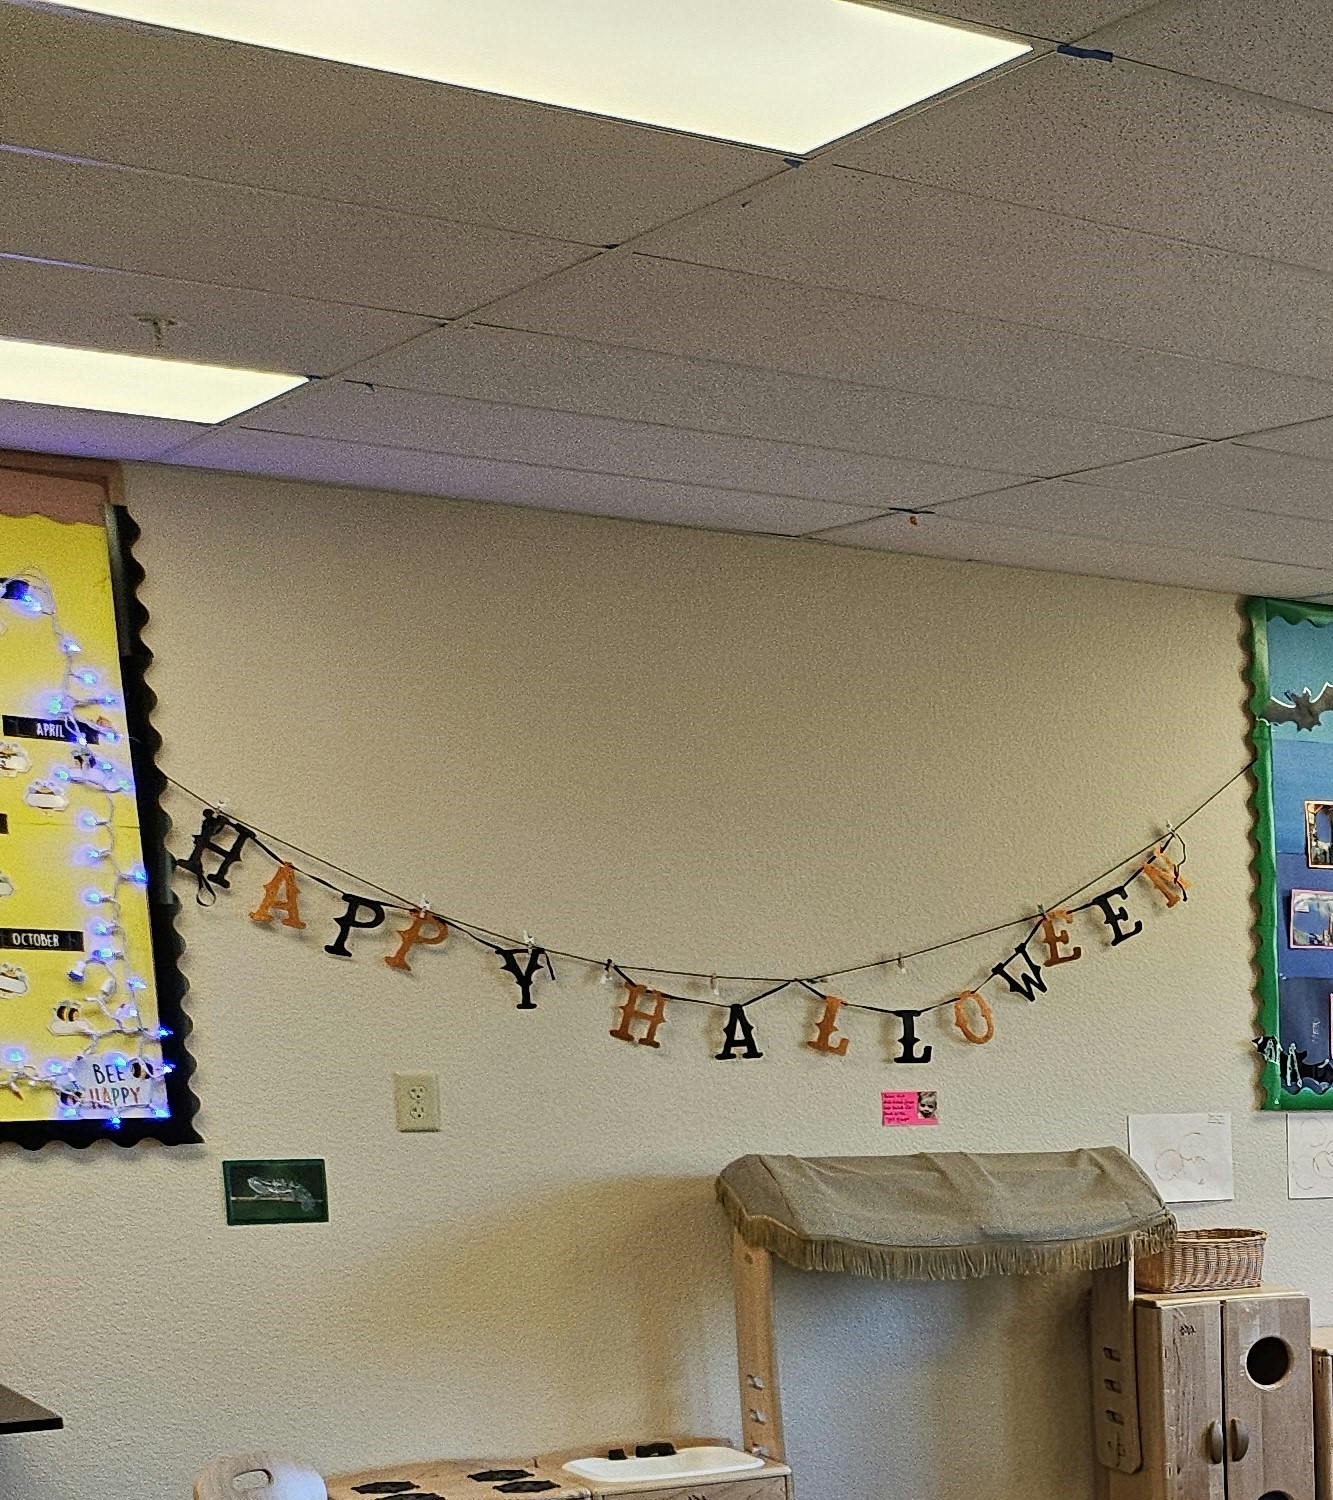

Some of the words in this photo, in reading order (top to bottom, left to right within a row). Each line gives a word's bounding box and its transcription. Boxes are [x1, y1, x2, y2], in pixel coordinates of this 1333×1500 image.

[36, 722, 65, 739] APRIL
[12, 932, 60, 947] OCTOBER
[176, 808, 544, 1010] HAPPY
[609, 842, 1193, 1065] HALLOWEEN
[92, 1063, 126, 1084] BEE
[88, 1086, 141, 1110] HAPPY
